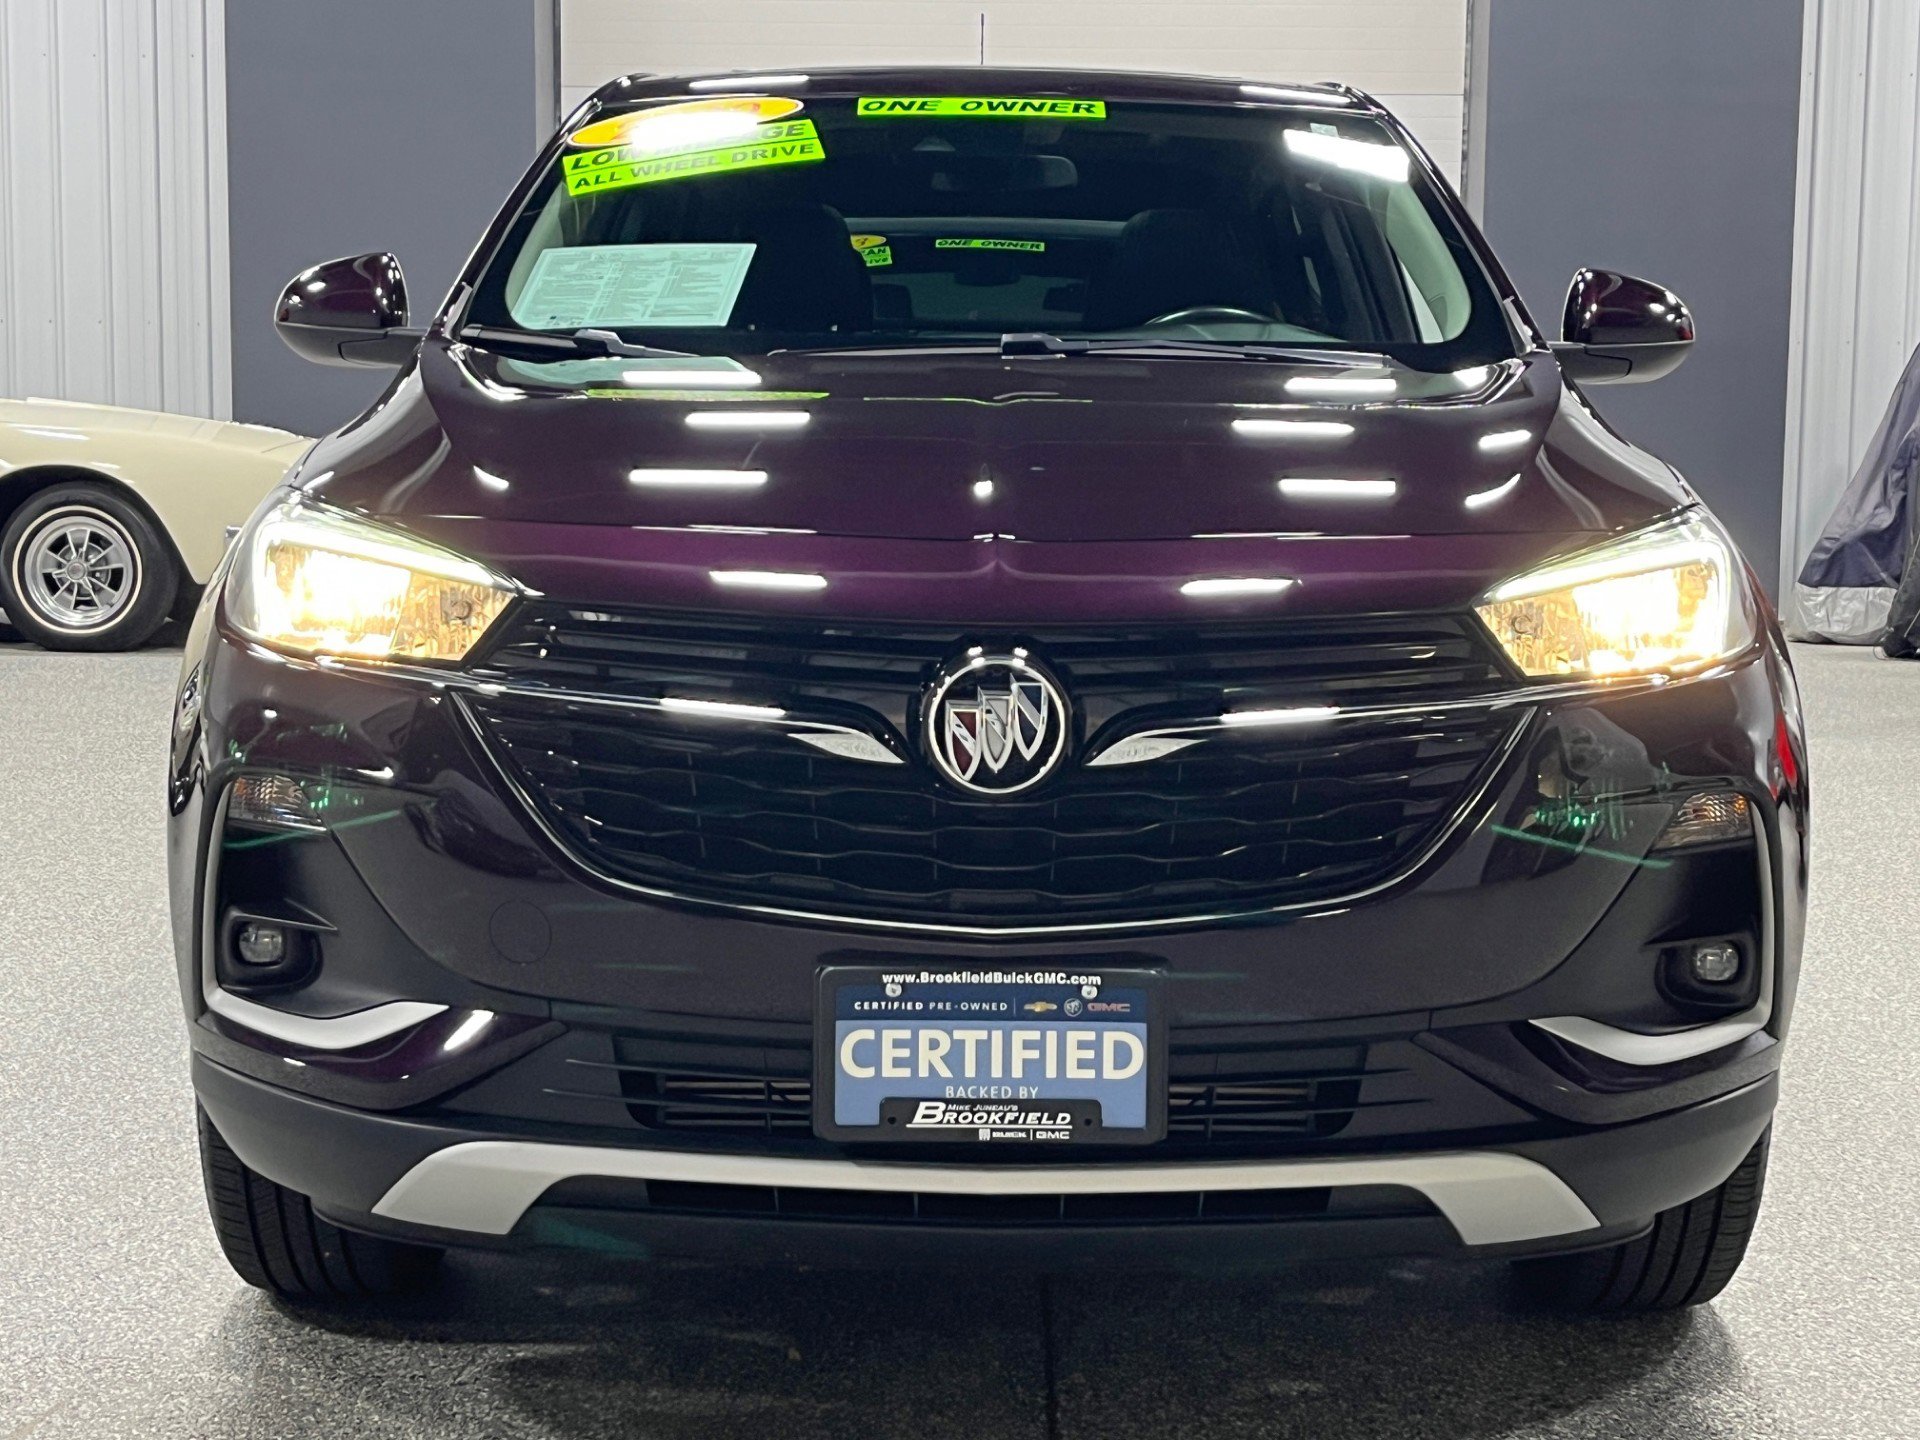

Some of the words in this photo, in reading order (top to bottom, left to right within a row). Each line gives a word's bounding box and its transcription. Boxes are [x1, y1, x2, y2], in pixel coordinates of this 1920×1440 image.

[863, 100, 943, 112] ONE
[960, 101, 1097, 114] OWNER
[570, 143, 642, 170] LOW
[574, 170, 623, 189] ALL
[630, 155, 722, 178] WHEEL
[731, 142, 815, 164] DRIVE
[937, 239, 971, 247] ONE
[980, 240, 1041, 250] OWNER
[882, 971, 1102, 986] www.BrookfieldBuickGMC.com
[854, 1001, 924, 1011] CERTIFIED
[1088, 1003, 1131, 1013] GMC
[840, 1029, 1145, 1080] CERTIFIED
[945, 1085, 1012, 1099] BACKED
[1019, 1086, 1039, 1099] BY
[912, 1101, 1071, 1125] BROOKFIELD
[1036, 1131, 1070, 1140] GMC
